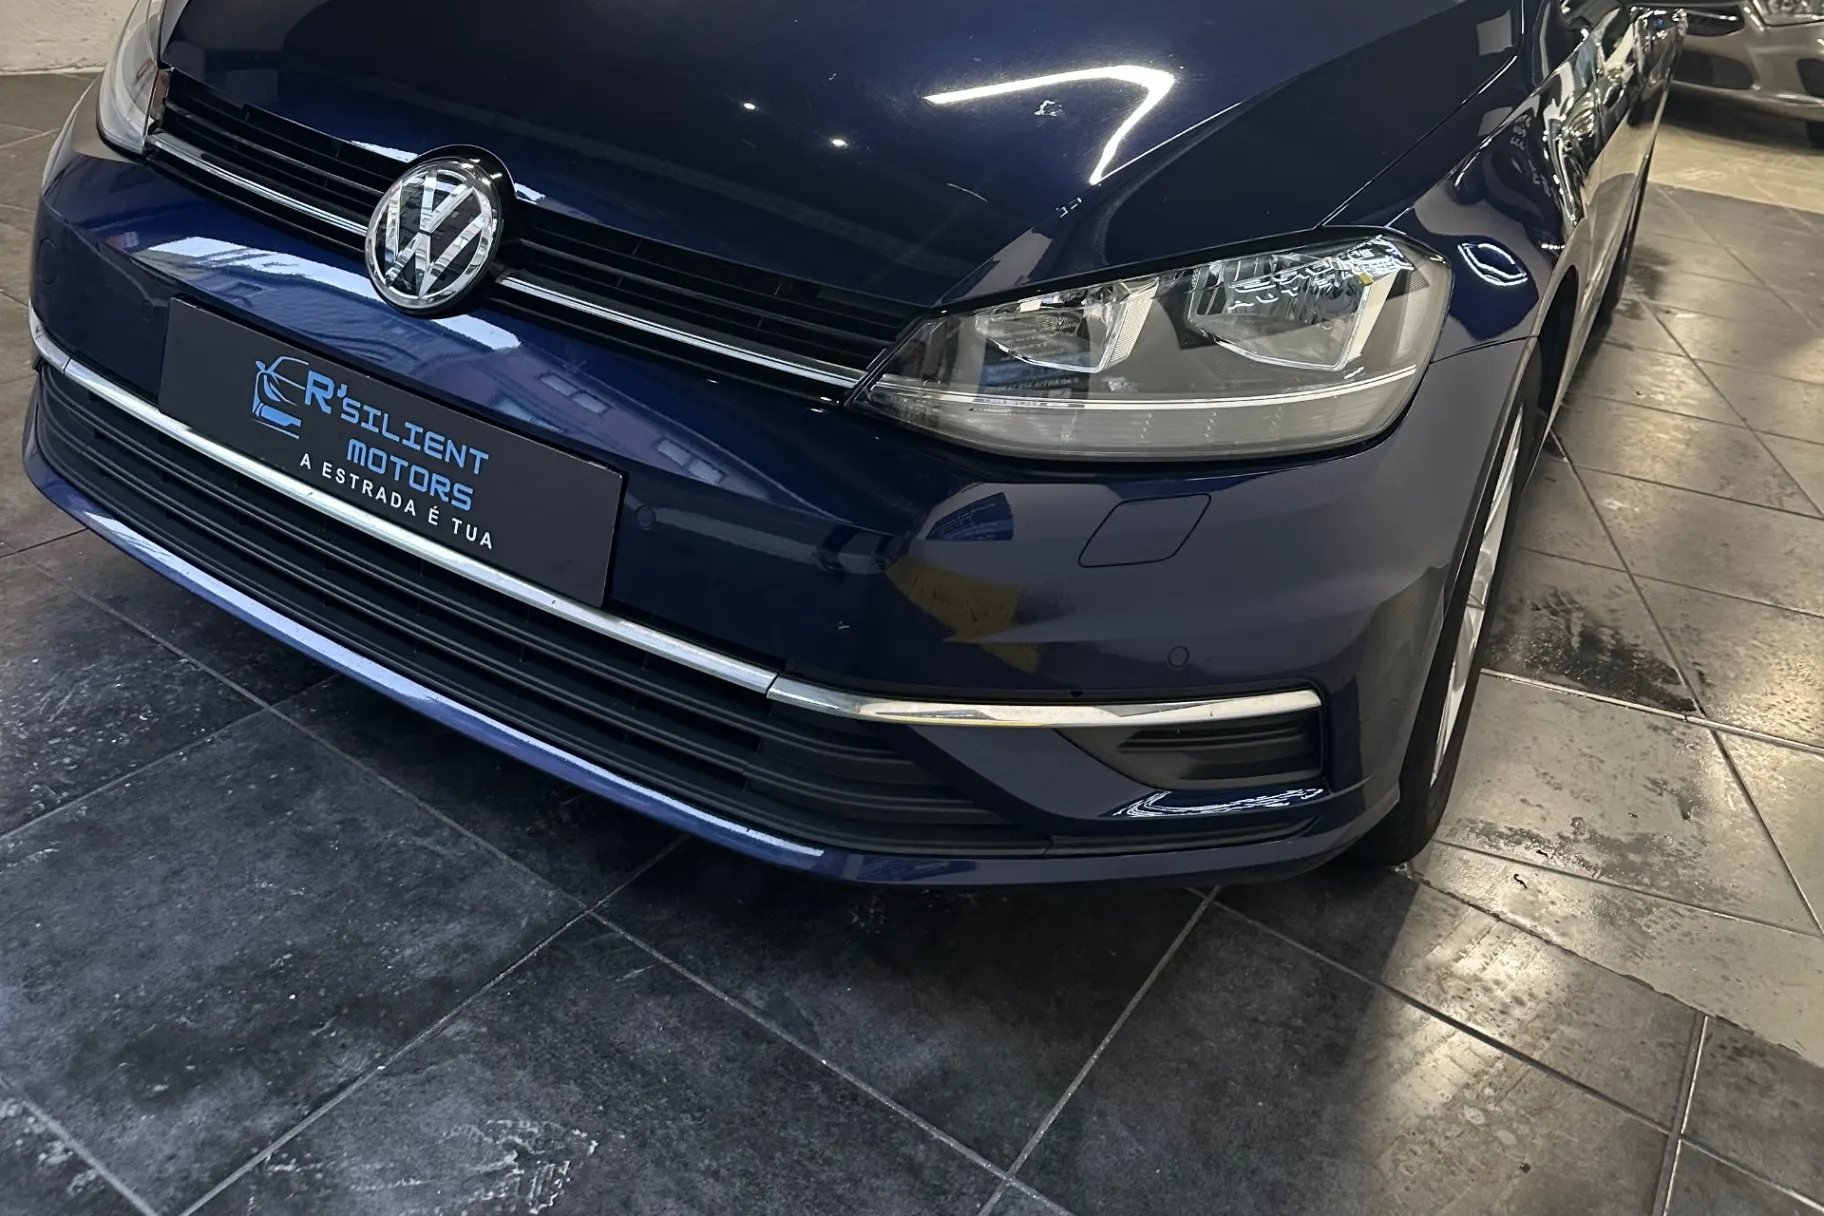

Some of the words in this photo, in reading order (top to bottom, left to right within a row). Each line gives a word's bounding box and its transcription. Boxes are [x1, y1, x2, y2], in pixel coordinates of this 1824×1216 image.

[304, 370, 489, 475] R'SILIENT
[300, 452, 312, 471] A
[322, 461, 417, 517] ESTRADA
[428, 505, 439, 526] É
[452, 517, 494, 550] TUA
[346, 438, 474, 512] MOTORS
